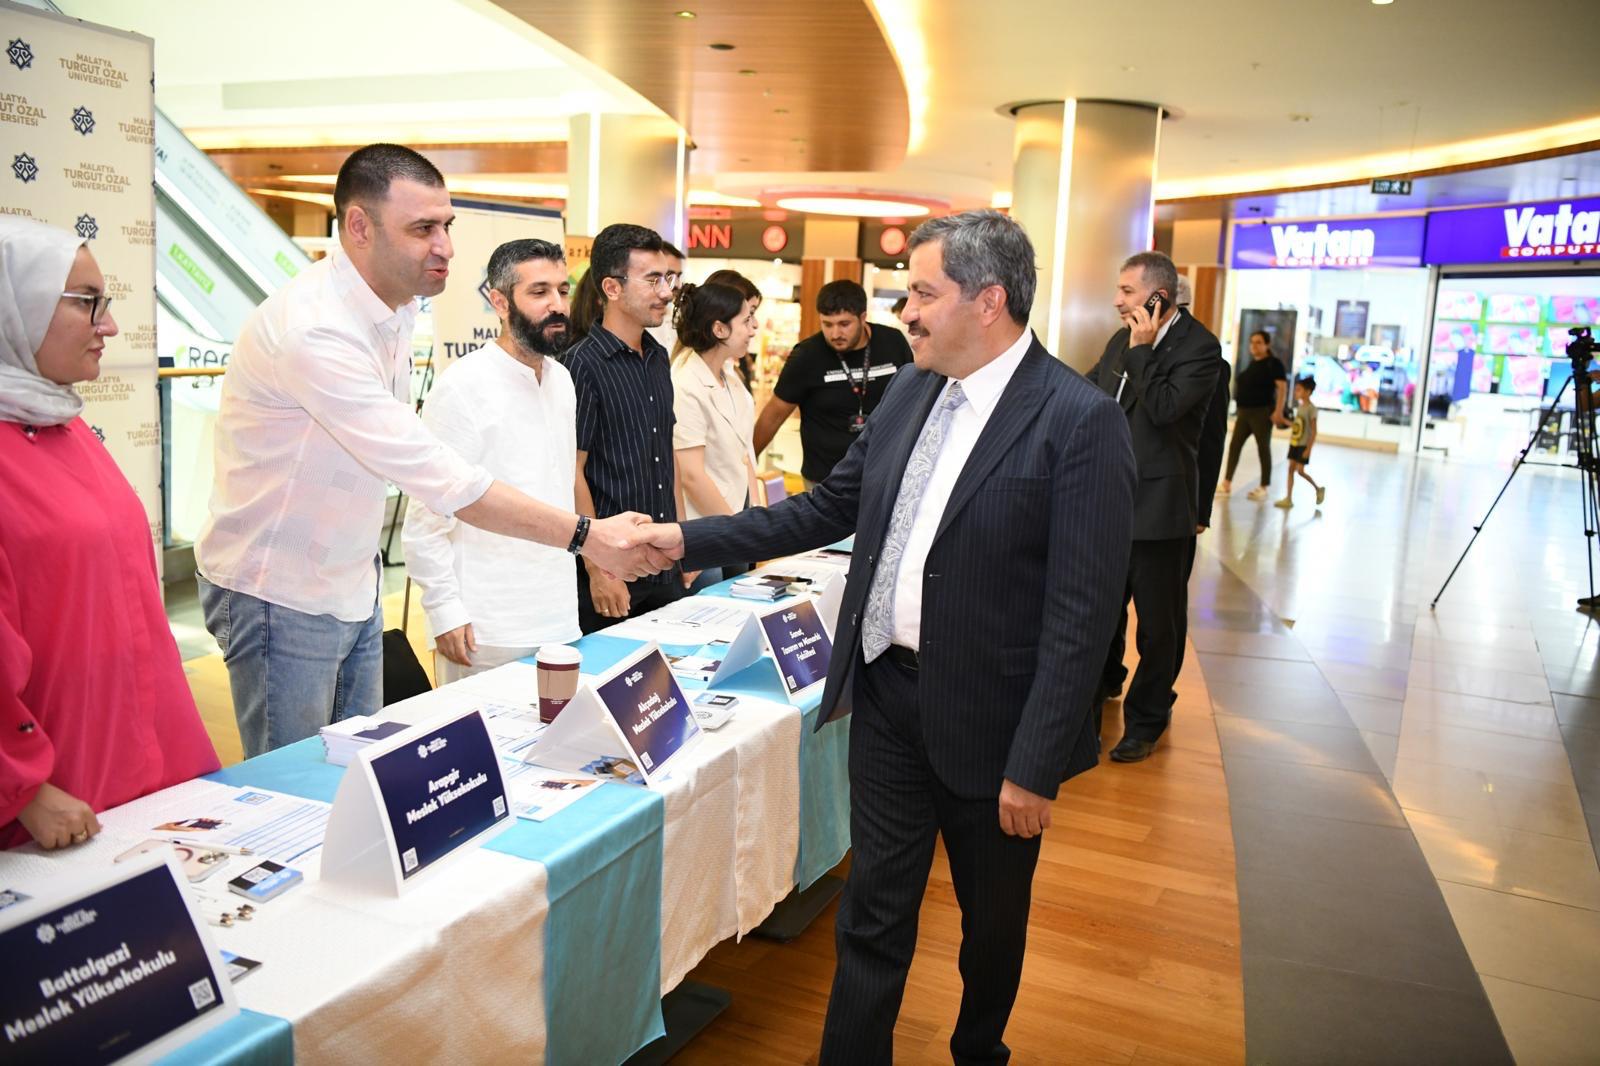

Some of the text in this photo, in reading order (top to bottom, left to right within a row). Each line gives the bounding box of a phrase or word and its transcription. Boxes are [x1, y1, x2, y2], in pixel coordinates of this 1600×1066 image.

[59, 57, 100, 75] TURGUT
[76, 53, 112, 67] MALATYA
[63, 167, 103, 182] TURGUT
[80, 161, 115, 173] MALATYA
[1504, 203, 1600, 248] Vata
[1270, 223, 1375, 259] Vatan
[1507, 245, 1600, 257] COMPUT
[443, 342, 486, 358] TUR
[632, 716, 652, 735] Meslek
[428, 768, 460, 793] Arapgir
[406, 772, 488, 825] Meslek Yüksekokulu
[39, 942, 131, 998] Battalgazi
[4, 1000, 74, 1042] Meslek
[72, 951, 177, 1008] Yüksekokulu
